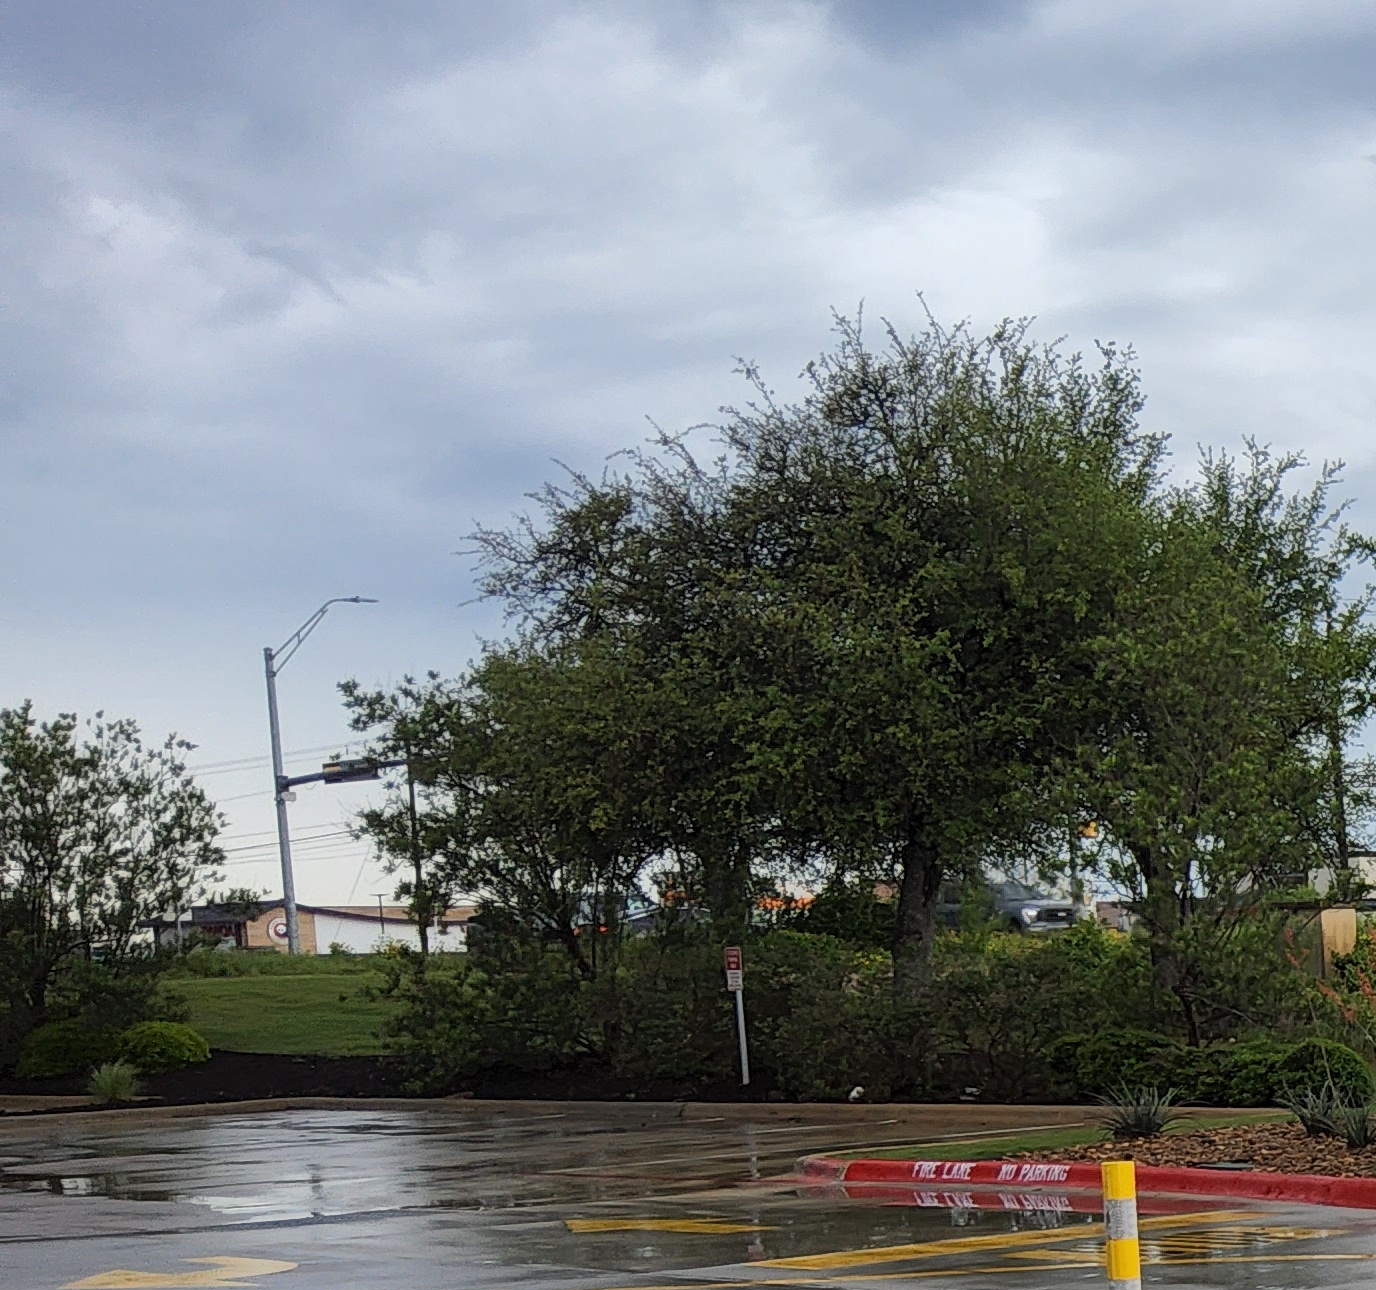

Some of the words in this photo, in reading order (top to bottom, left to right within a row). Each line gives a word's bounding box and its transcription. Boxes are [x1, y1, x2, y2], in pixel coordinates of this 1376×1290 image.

[912, 1162, 942, 1179] FIRE
[942, 1162, 977, 1181] LANE
[998, 1164, 1017, 1181] NO
[1018, 1164, 1071, 1182] PARKING
